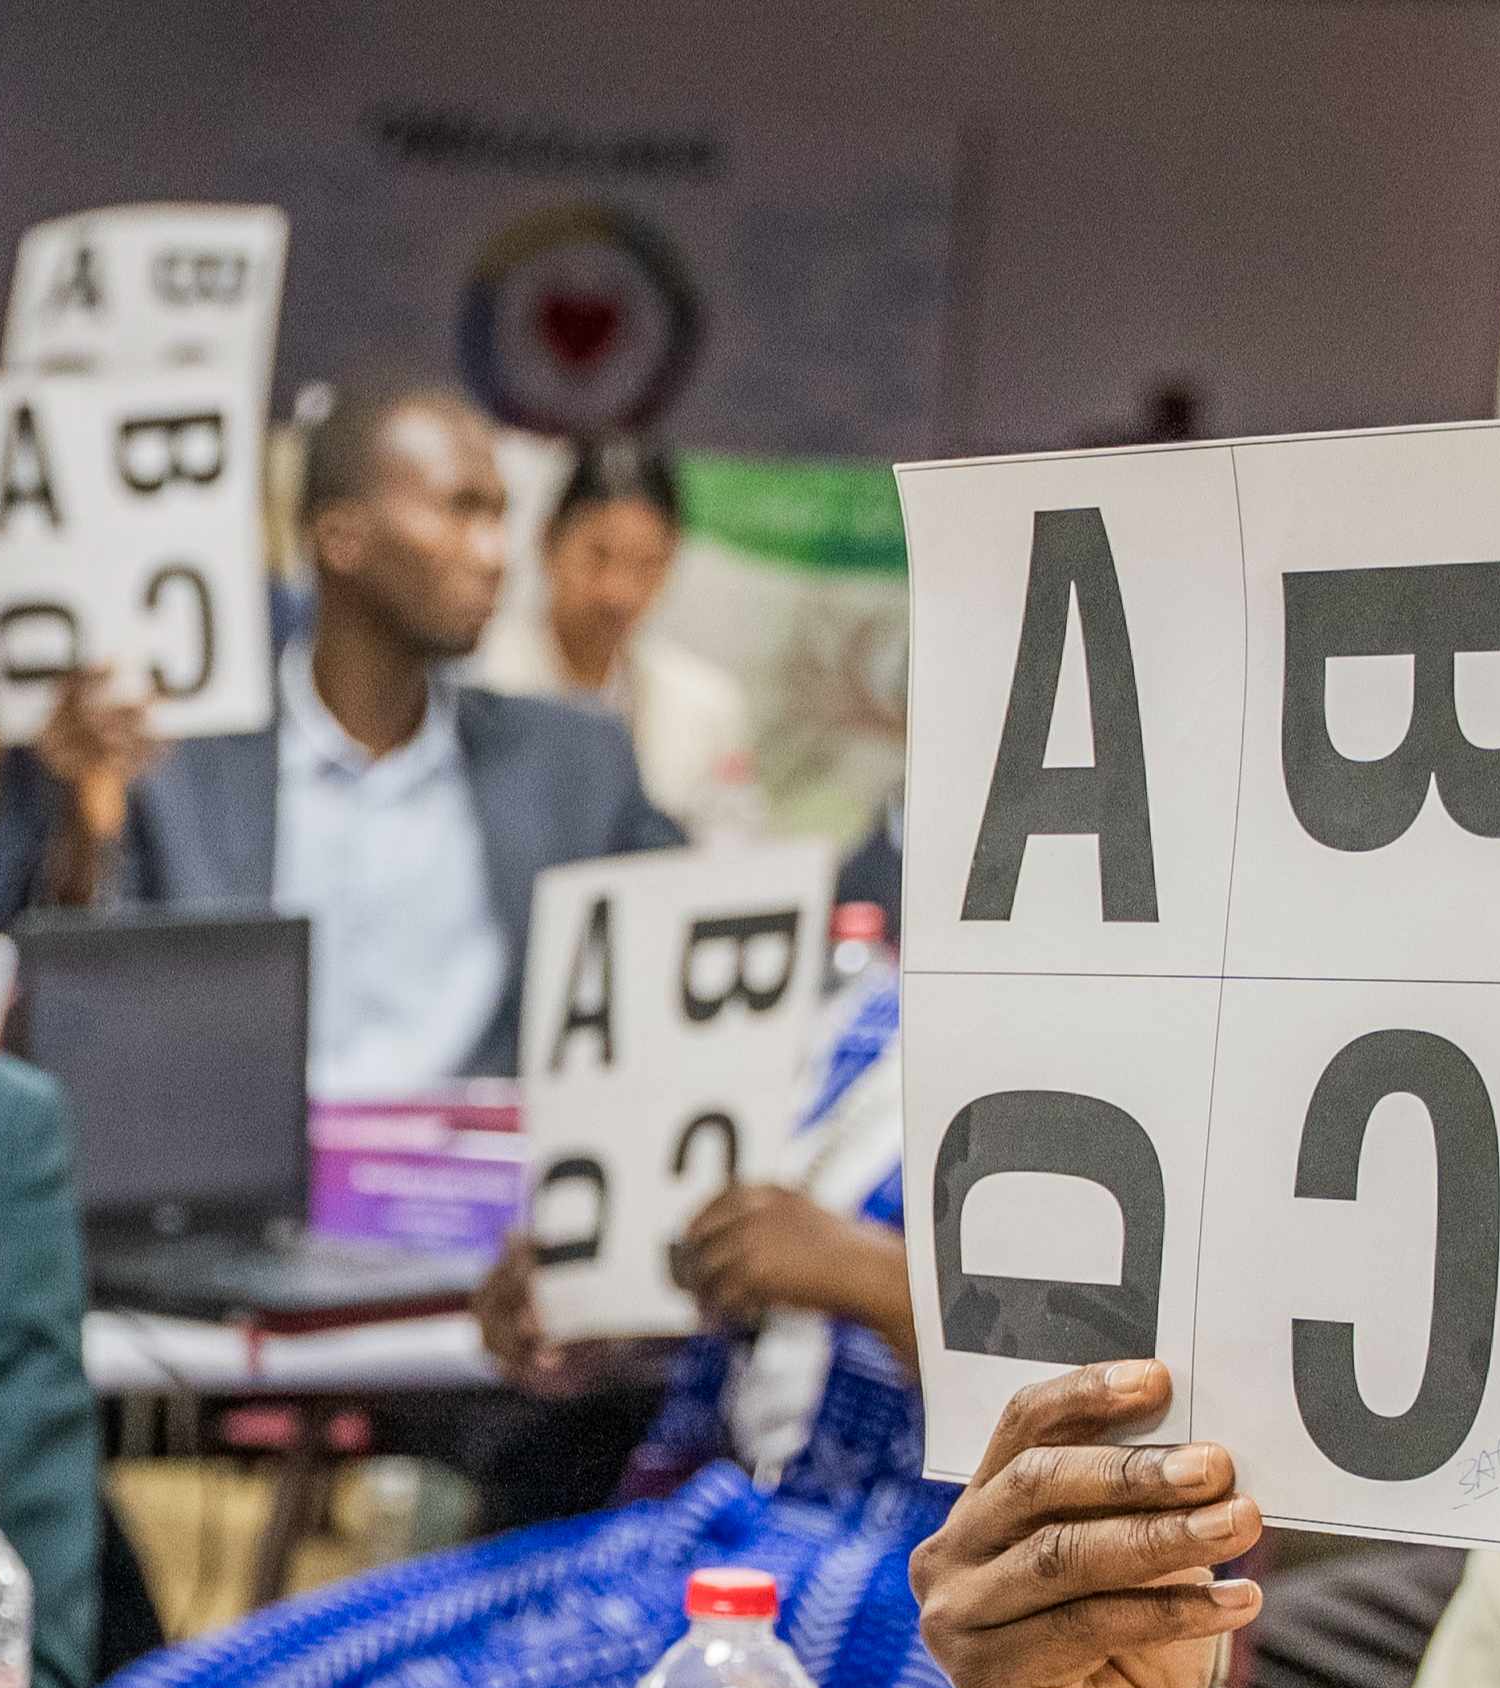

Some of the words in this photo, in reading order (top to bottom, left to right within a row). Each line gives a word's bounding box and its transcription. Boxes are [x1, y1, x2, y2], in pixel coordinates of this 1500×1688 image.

[115, 411, 227, 498] B
[144, 565, 218, 700] C
[960, 506, 1160, 923] A
[551, 893, 618, 1072] A
[679, 907, 803, 1025] B
[932, 1089, 1166, 1367] D
[1291, 1028, 1500, 1482] C
